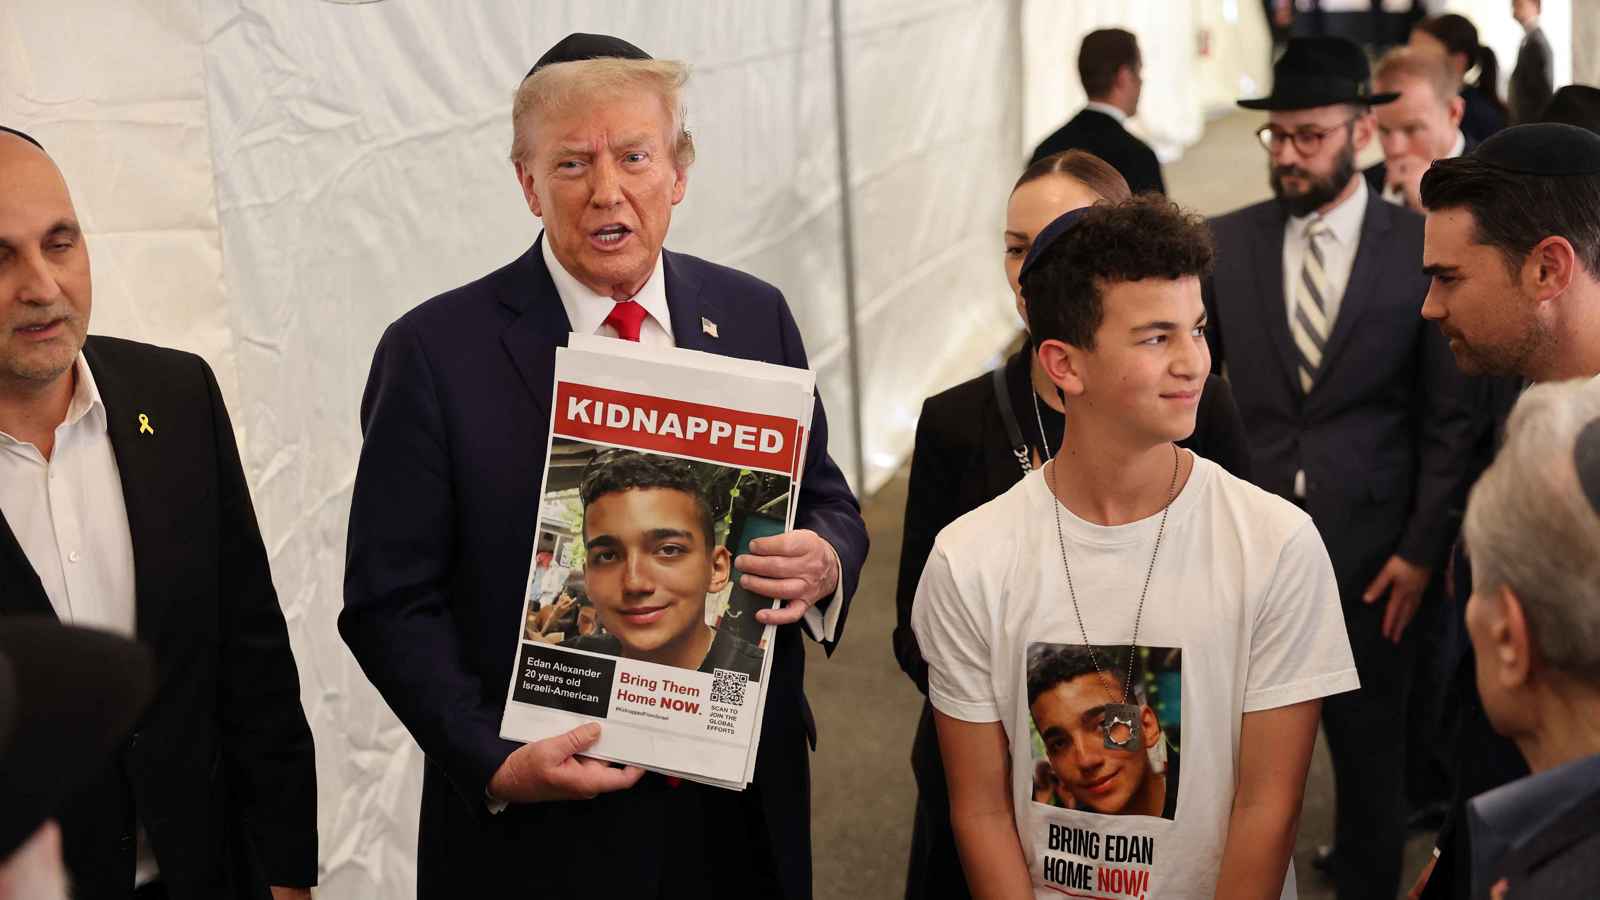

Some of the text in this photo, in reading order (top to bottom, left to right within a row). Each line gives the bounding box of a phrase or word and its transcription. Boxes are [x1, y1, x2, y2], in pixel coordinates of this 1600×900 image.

[567, 396, 784, 453] KIDNAPPED
[524, 669, 581, 687] 20 years old
[527, 657, 602, 679] Edan Alexander
[522, 680, 599, 703] Israeli-American
[620, 672, 700, 697] Bring Them
[617, 689, 657, 706] Home
[660, 697, 703, 716] NOW.
[711, 705, 728, 713] SCAN
[706, 724, 735, 735] EFFORTS
[709, 718, 734, 728] GLOBAL
[1048, 823, 1154, 865] BRING EDAN
[1043, 855, 1150, 900] HOME NOW!
